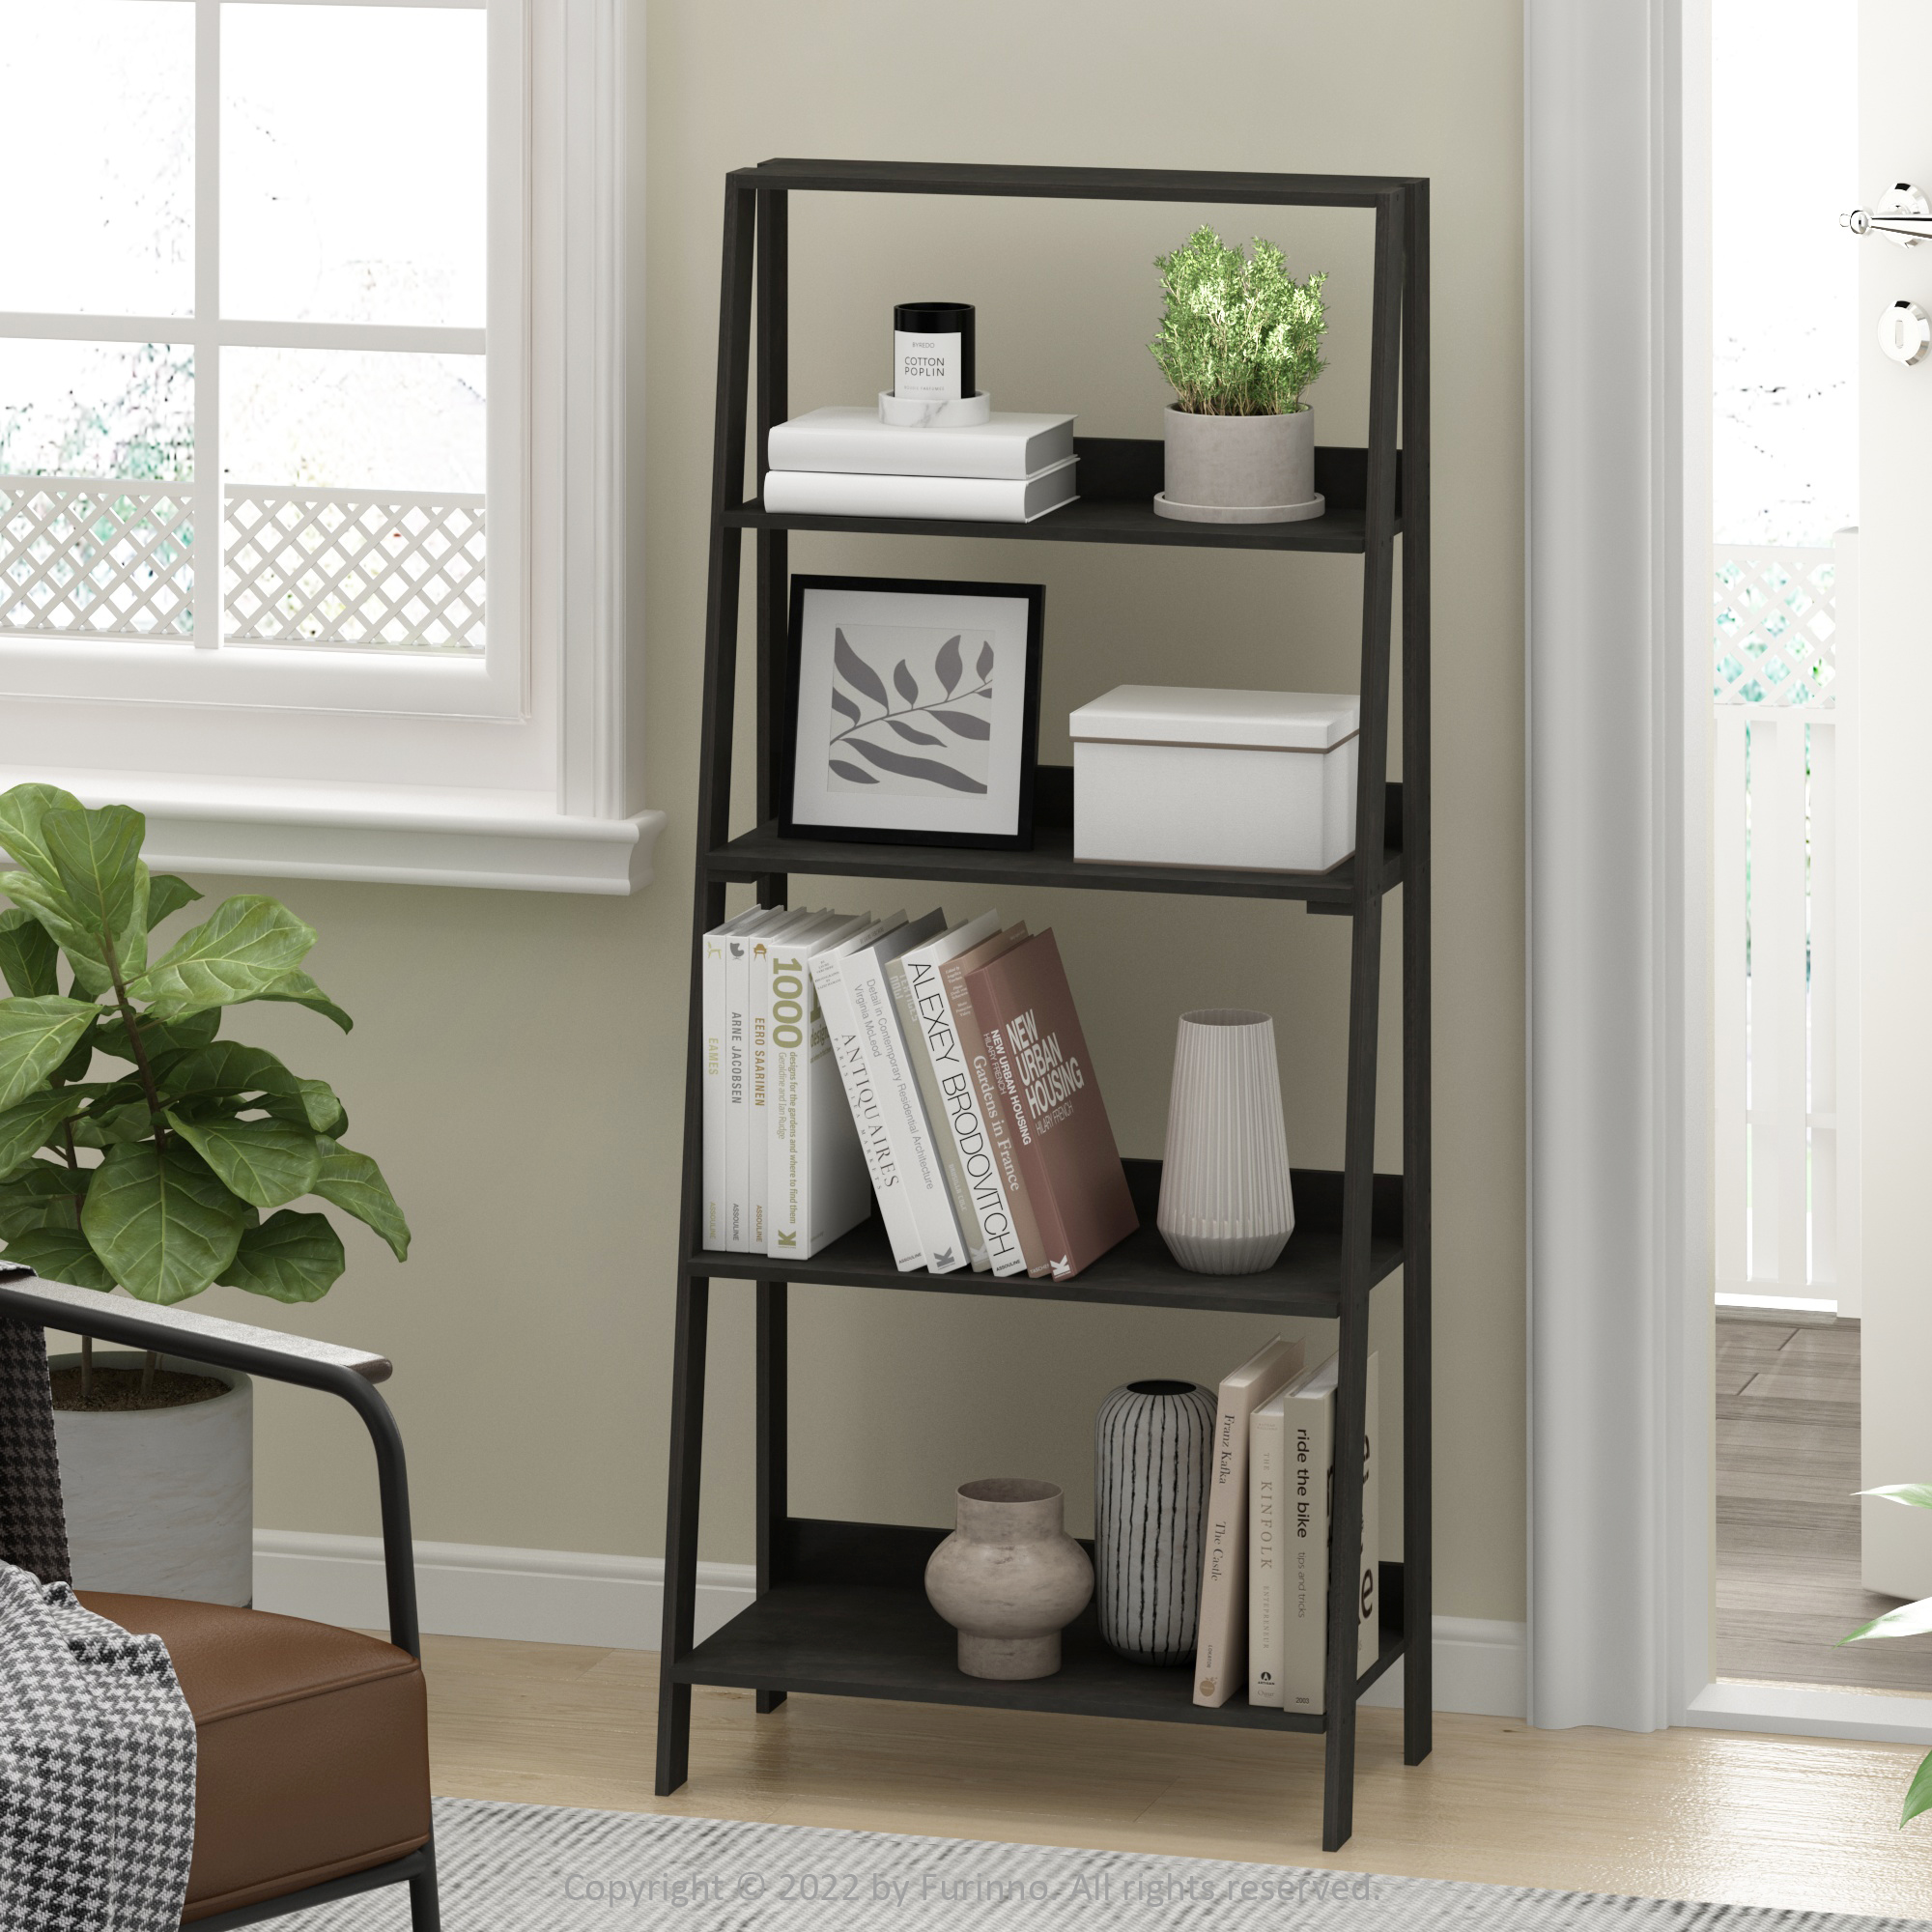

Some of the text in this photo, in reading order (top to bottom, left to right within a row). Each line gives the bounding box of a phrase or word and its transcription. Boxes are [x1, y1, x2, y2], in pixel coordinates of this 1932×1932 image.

[904, 356, 945, 366] COTTON
[904, 367, 945, 377] POPLIN
[773, 957, 803, 1049] 1000
[854, 983, 882, 1058] Virginia McLeod
[1006, 1008, 1038, 1055] NEW
[708, 1037, 719, 1075] EAMES
[731, 1011, 742, 1104] ARNE JACOBSEN
[754, 1017, 765, 1107] EERO SAARINEN
[777, 1052, 786, 1140] Geraldine and Ian Rudge
[866, 979, 933, 1190] Detail in Contemporary Residential Architecture
[983, 1033, 1007, 1095] HILARY FRENCH
[990, 1029, 1032, 1146] NEW URBAN HOUSING
[1015, 1032, 1064, 1087] URBAN
[1025, 1056, 1085, 1120] HOUSING
[788, 1051, 798, 1224] designs for the gardens and where to find them
[834, 1037, 848, 1077] PARIS
[861, 1129, 881, 1190] MARKETS
[841, 1034, 899, 1187] ANTIQUAIRES
[907, 963, 1015, 1257] ALEXEY BRODOVITCH
[973, 1055, 1019, 1192] Gardens in France
[1035, 1099, 1074, 1136] HILARY FRENCH
[996, 1259, 1021, 1272] ASSOULINE
[1210, 1414, 1236, 1581] Franz Kafka The Castle
[1261, 1481, 1272, 1569] KINFOLK
[1296, 1429, 1310, 1619] ride the bike tips and tricks
